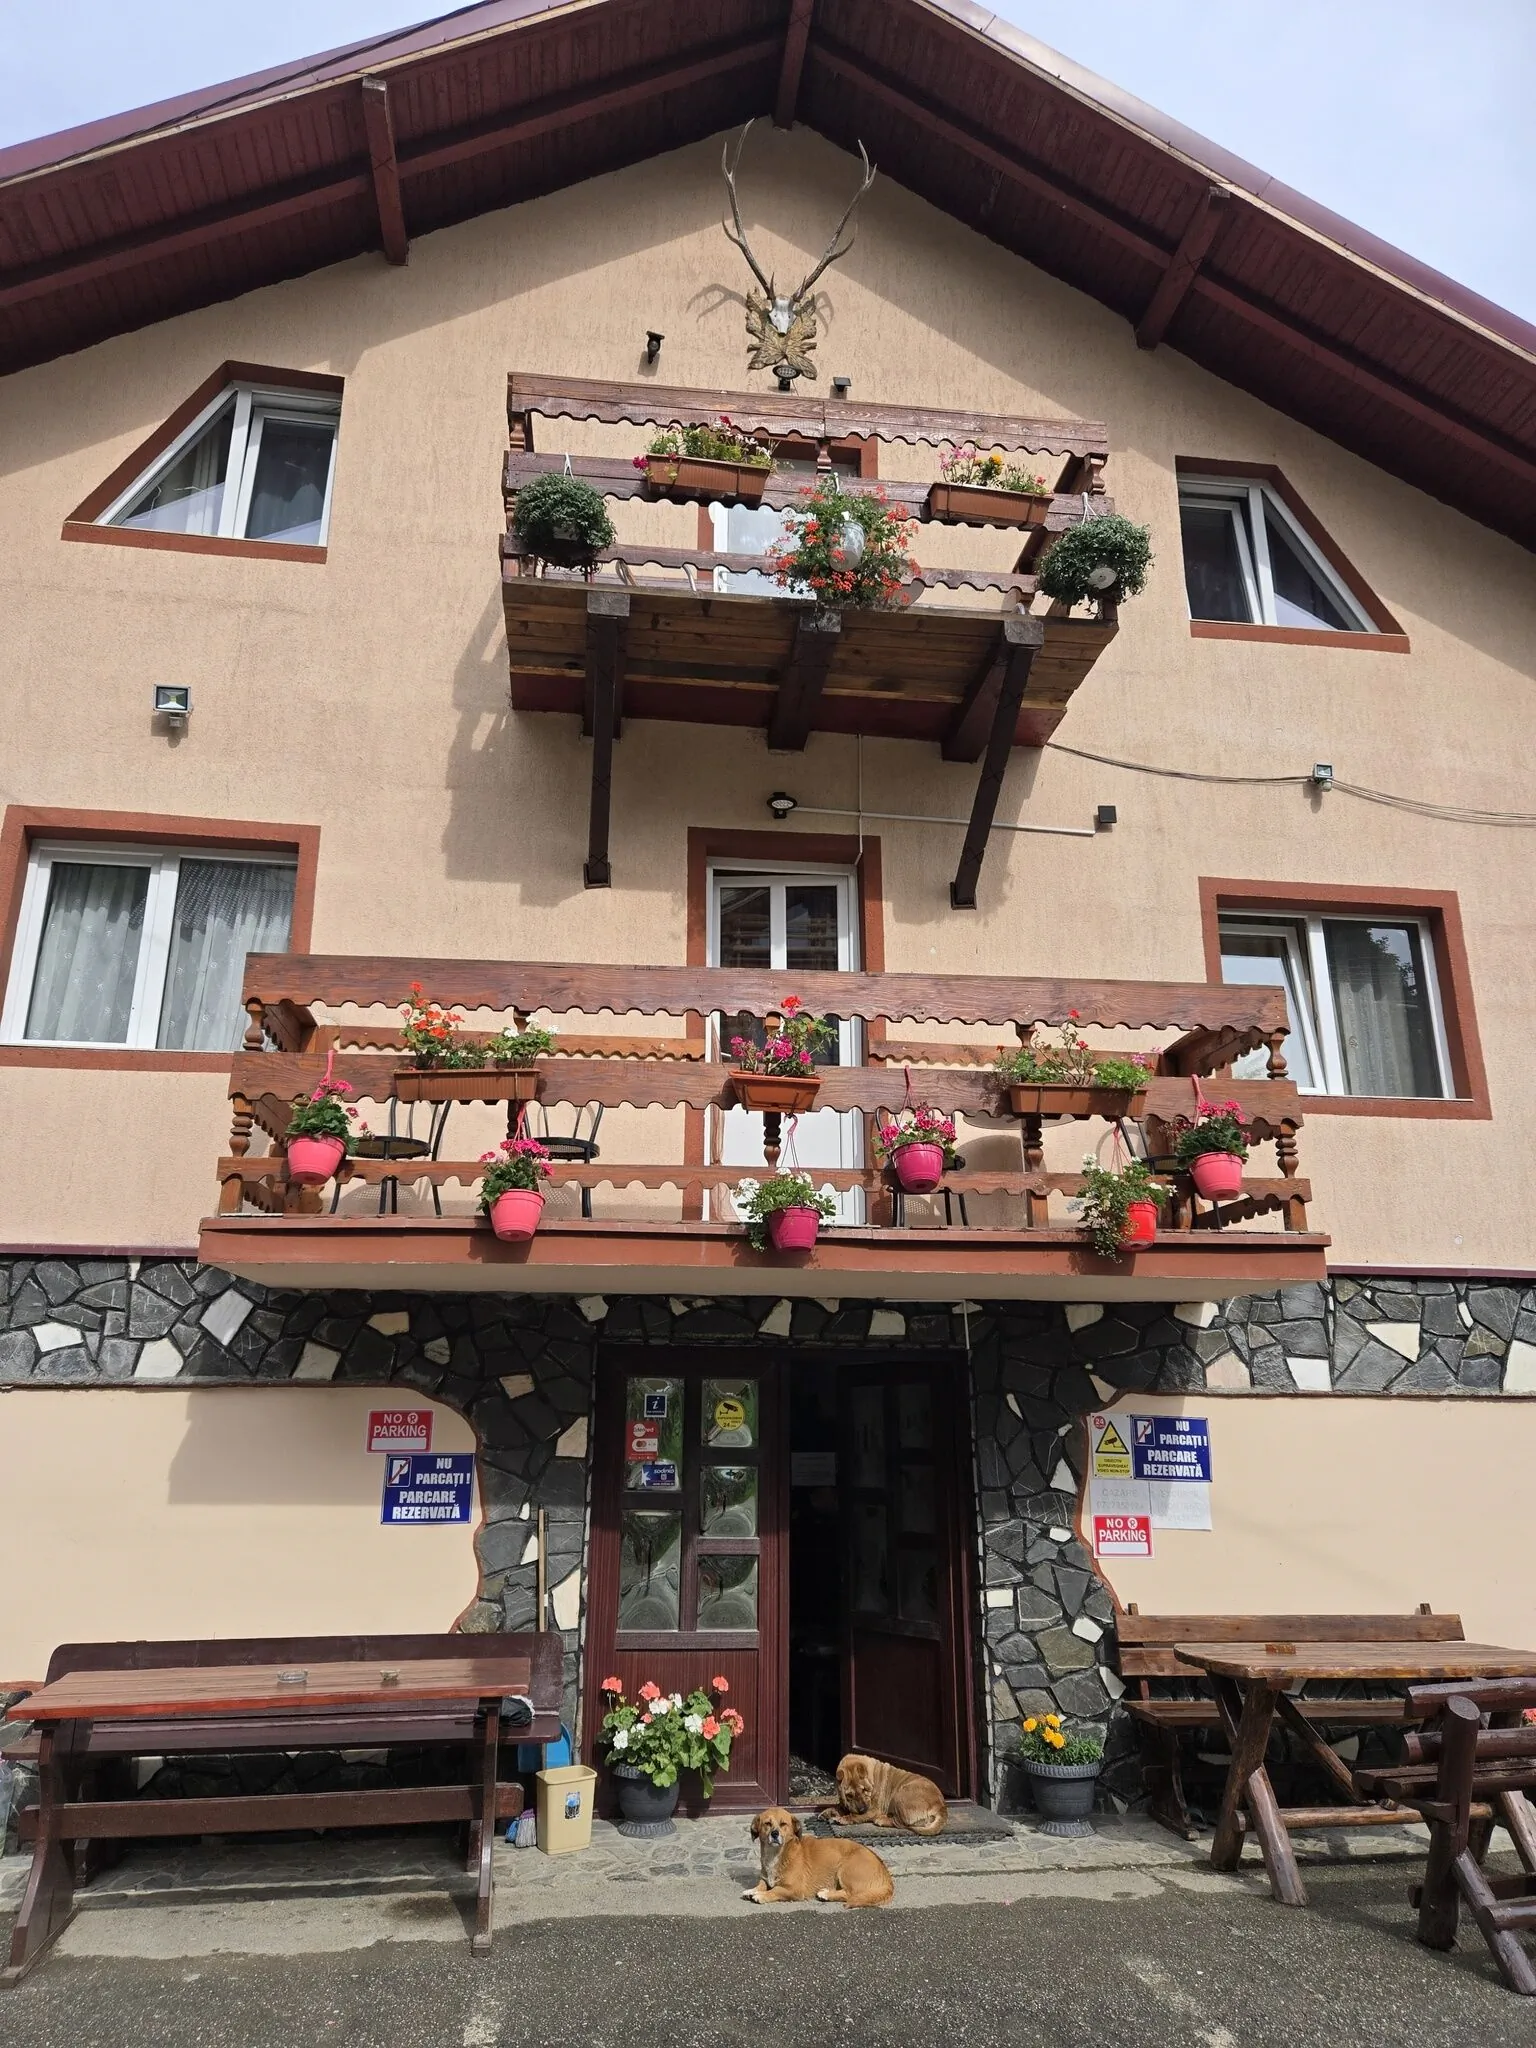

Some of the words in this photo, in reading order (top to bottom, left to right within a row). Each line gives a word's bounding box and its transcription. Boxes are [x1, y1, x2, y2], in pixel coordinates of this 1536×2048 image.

[383, 1413, 403, 1424] NO
[373, 1425, 427, 1437] PARKING
[1175, 1420, 1190, 1432] NU
[1147, 1449, 1198, 1463] PARCARE
[436, 1458, 452, 1469] NU
[1143, 1463, 1203, 1477] REZERVATĂ
[399, 1491, 456, 1503] PARCARE
[391, 1503, 461, 1519] REZERVATĂ
[1106, 1518, 1124, 1528] NO
[1098, 1530, 1147, 1541] PARKING
